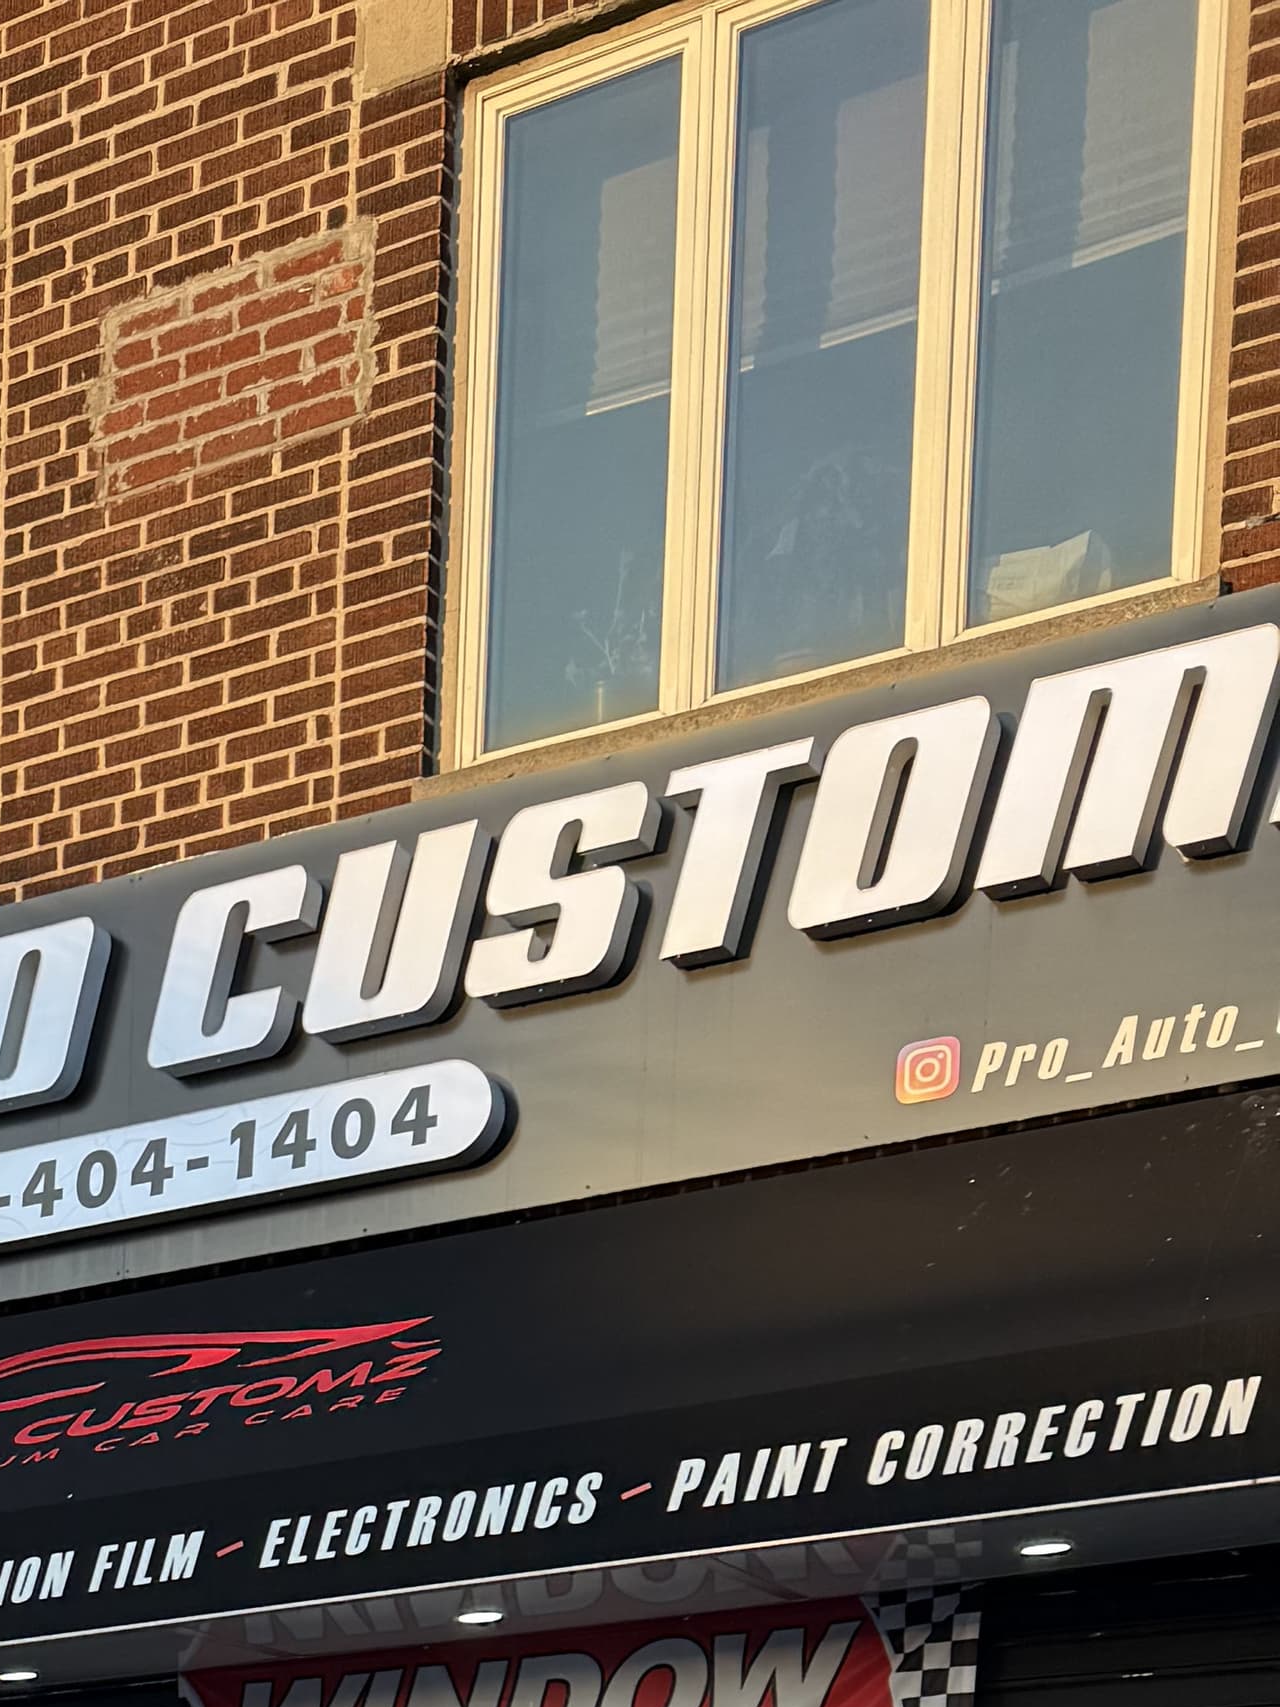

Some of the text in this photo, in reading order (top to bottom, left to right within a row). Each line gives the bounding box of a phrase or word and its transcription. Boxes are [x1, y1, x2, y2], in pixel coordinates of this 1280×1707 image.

[146, 620, 1280, 1080] CUSTOM
[970, 1002, 1280, 1094] Pro_Auto_
[13, 1342, 443, 1448] CUSTOMZ
[94, 1420, 208, 1454] CAR
[244, 1384, 406, 1428] CARE
[88, 1529, 207, 1594] FILM
[257, 1471, 604, 1571] ELECTRONICS
[666, 1438, 848, 1514] PAINT
[866, 1374, 1263, 1487] CORRECTION
